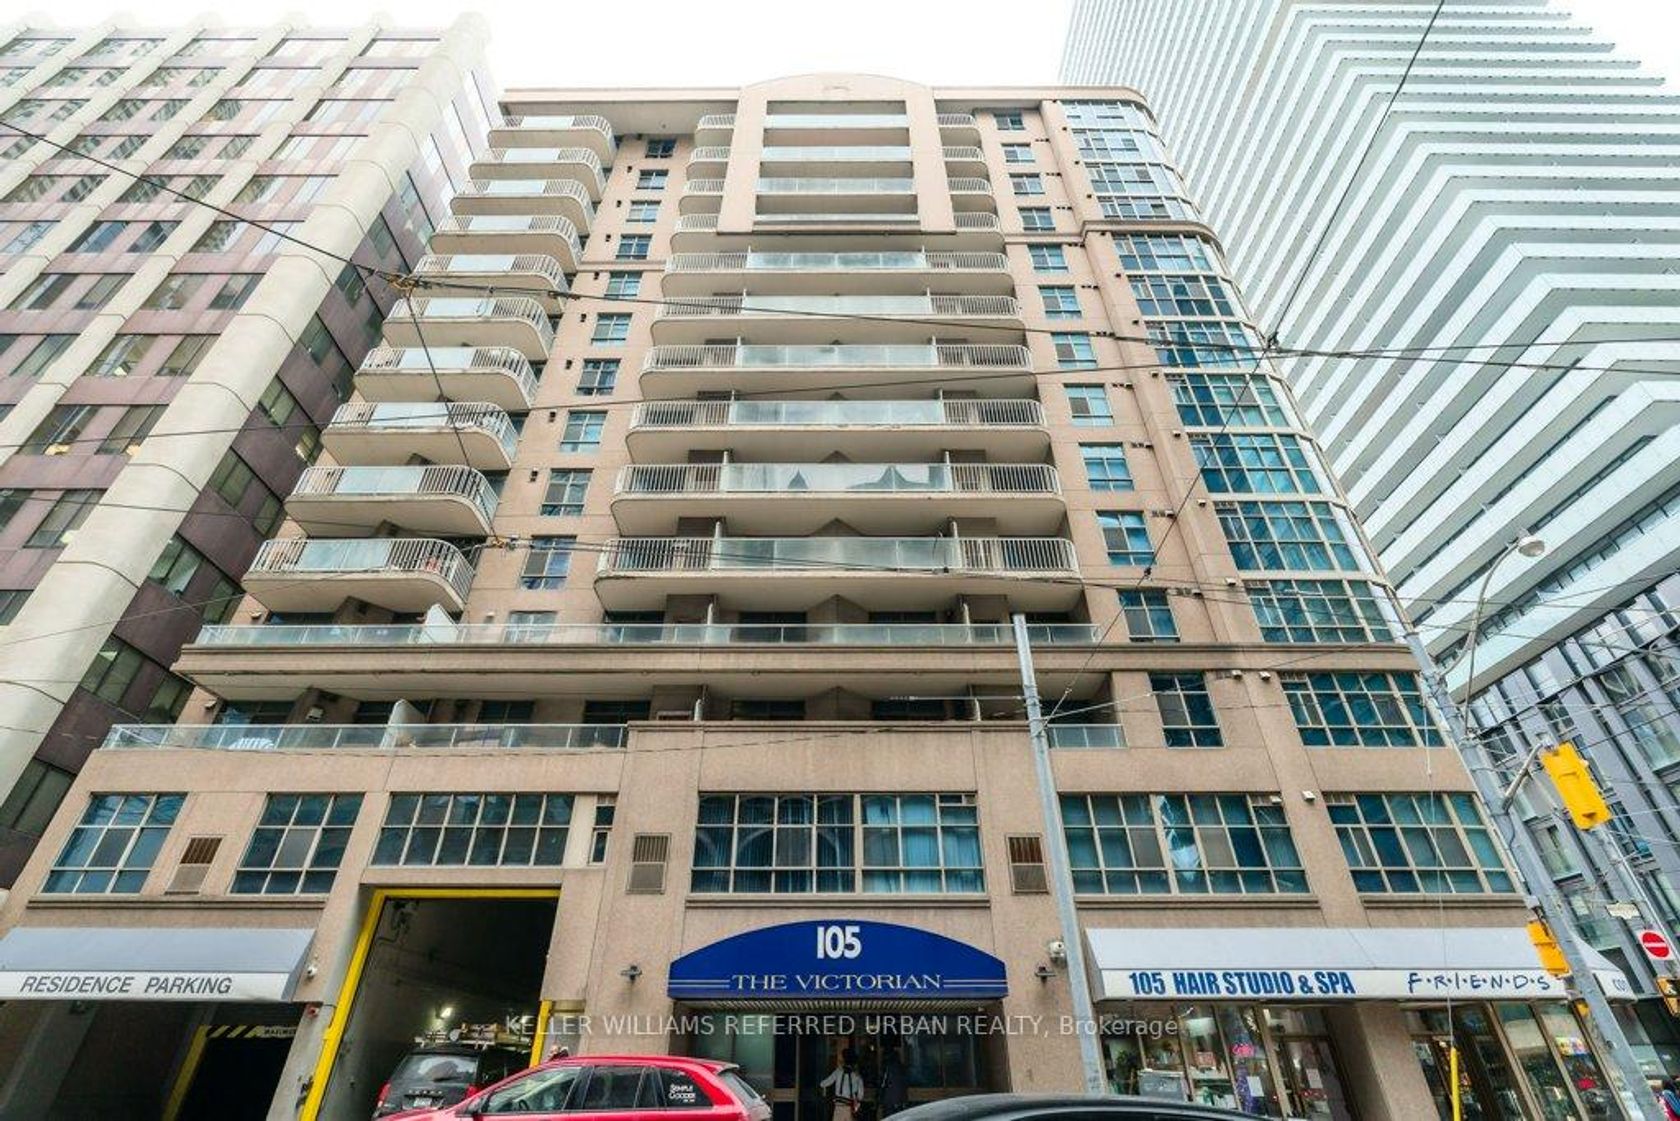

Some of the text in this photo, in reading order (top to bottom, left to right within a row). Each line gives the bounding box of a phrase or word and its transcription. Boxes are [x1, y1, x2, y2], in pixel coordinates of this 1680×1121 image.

[817, 925, 862, 960] 105
[20, 976, 233, 994] RESIDENCE PARKING
[731, 974, 942, 990] THE VICTORIAN
[1129, 971, 1356, 995] 105 HAIR STUDIO & SPA
